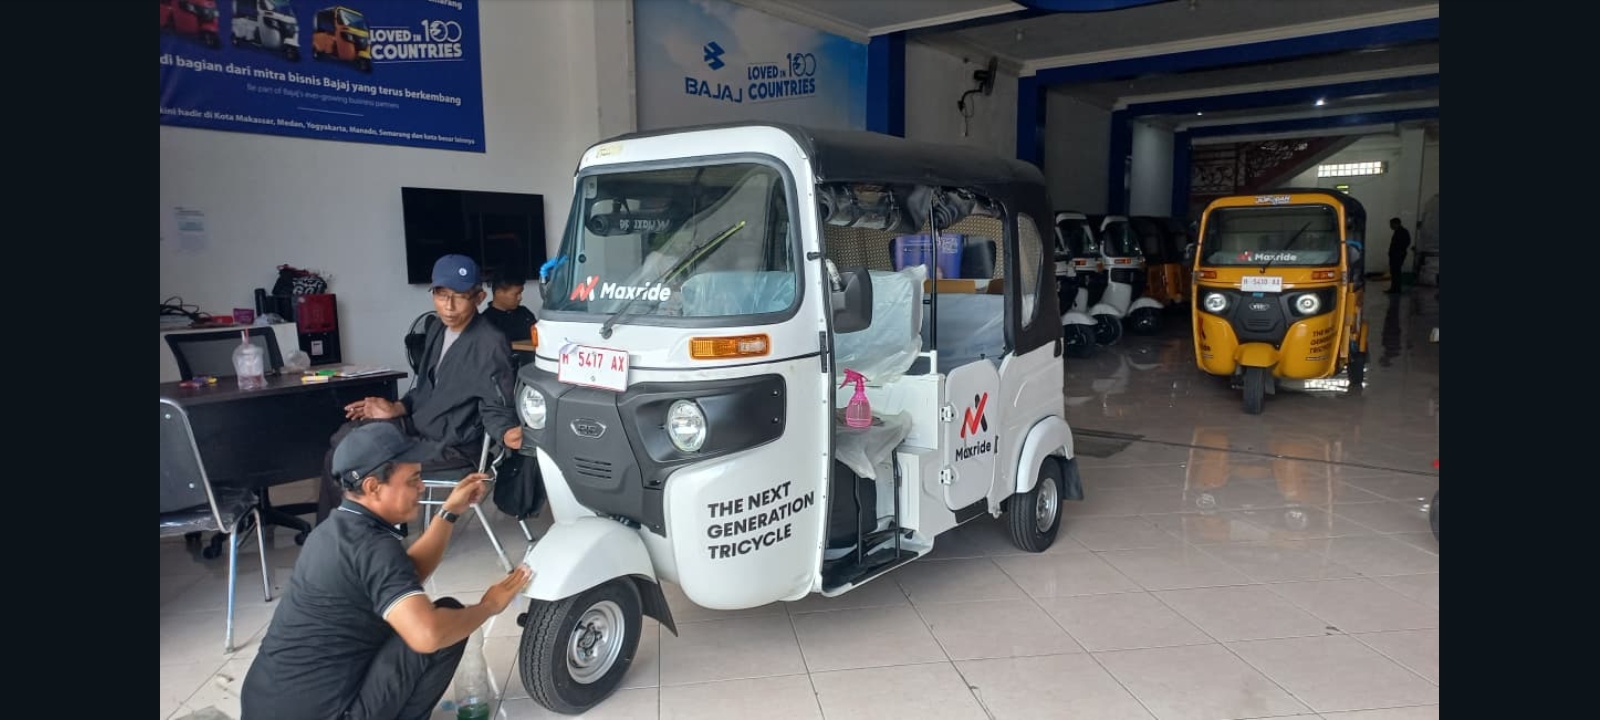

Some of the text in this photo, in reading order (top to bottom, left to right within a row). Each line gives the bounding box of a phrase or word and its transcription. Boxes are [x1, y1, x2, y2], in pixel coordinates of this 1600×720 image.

[369, 29, 412, 42] LOVED
[421, 19, 462, 42] 100
[371, 43, 463, 60] COUNTRIES
[747, 65, 778, 80] LOVED
[786, 53, 817, 77] 100
[176, 55, 222, 72] bagian
[226, 62, 251, 76] dari
[254, 68, 286, 81] mitra
[288, 72, 321, 86] bisnis
[324, 77, 350, 93] Bajaj
[353, 83, 377, 96] yang
[379, 86, 403, 97] terus
[405, 88, 462, 106] berkembang
[685, 76, 743, 103] BAJAJ
[748, 78, 816, 100] COUNTRIES
[178, 107, 202, 117] hadir
[204, 111, 213, 119] di
[214, 112, 235, 121] Kota
[379, 129, 411, 140] Semarang
[1255, 253, 1297, 261] Maxride
[599, 281, 671, 302] Maxride
[578, 351, 604, 369] 5417
[610, 355, 625, 372] AX
[955, 440, 992, 462] Maxride
[708, 480, 791, 518] THE NEXT
[707, 491, 815, 539] GENERATION
[708, 523, 792, 560] TRICYCLE
